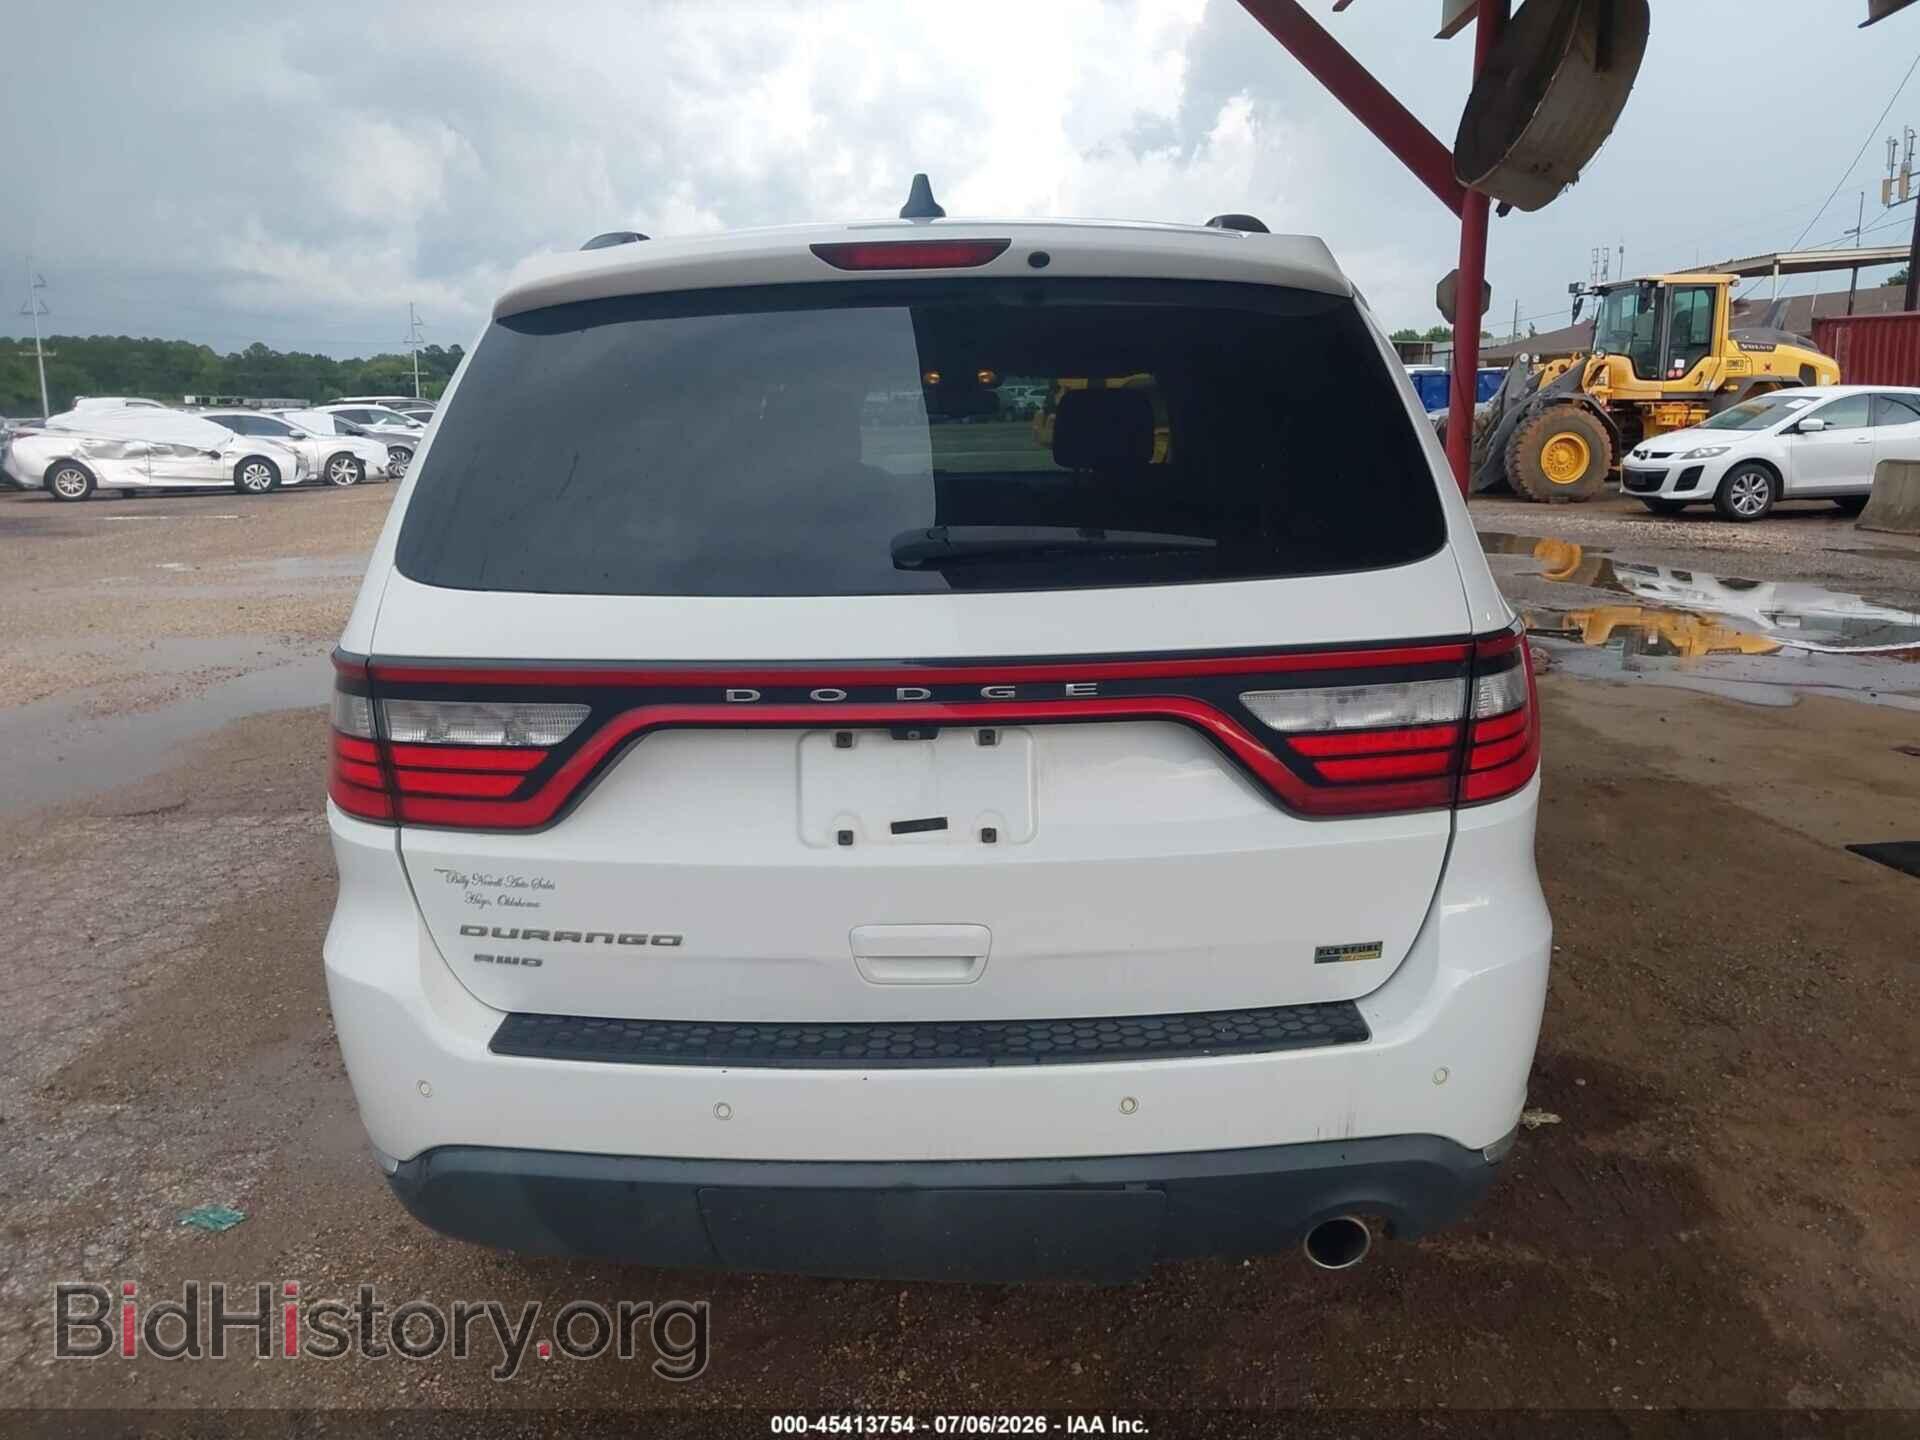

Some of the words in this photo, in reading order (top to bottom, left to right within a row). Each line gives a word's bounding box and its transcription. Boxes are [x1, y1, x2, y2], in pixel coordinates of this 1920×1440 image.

[726, 682, 1097, 702] DODGE
[459, 924, 683, 947] DURANGO
[473, 953, 543, 968] AWD
